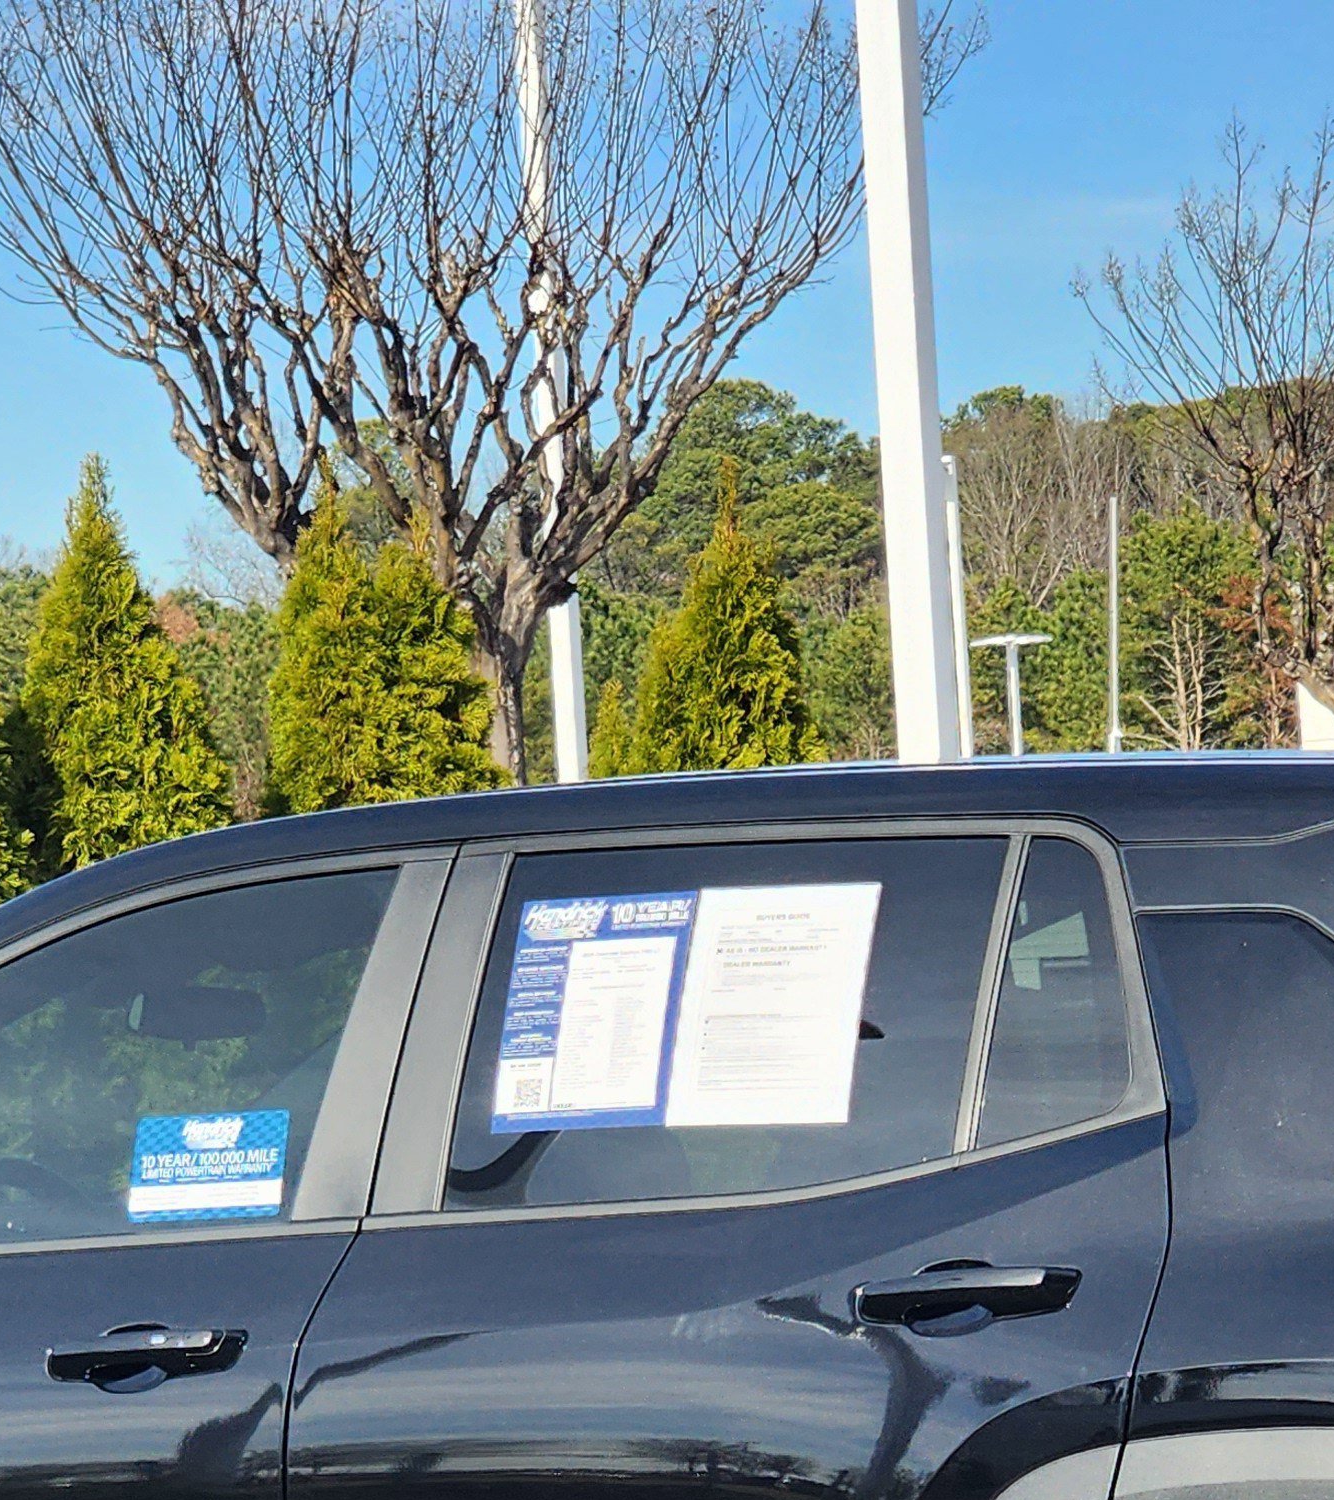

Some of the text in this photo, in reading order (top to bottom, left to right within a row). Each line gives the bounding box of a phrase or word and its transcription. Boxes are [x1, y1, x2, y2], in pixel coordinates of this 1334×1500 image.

[611, 903, 636, 925] 10
[141, 1155, 156, 1168] 10
[246, 1148, 279, 1163] MILE
[141, 1167, 174, 1179] LIMITED
[175, 1164, 226, 1178] POWERTRAIN
[227, 1162, 272, 1175] WARRANTY
